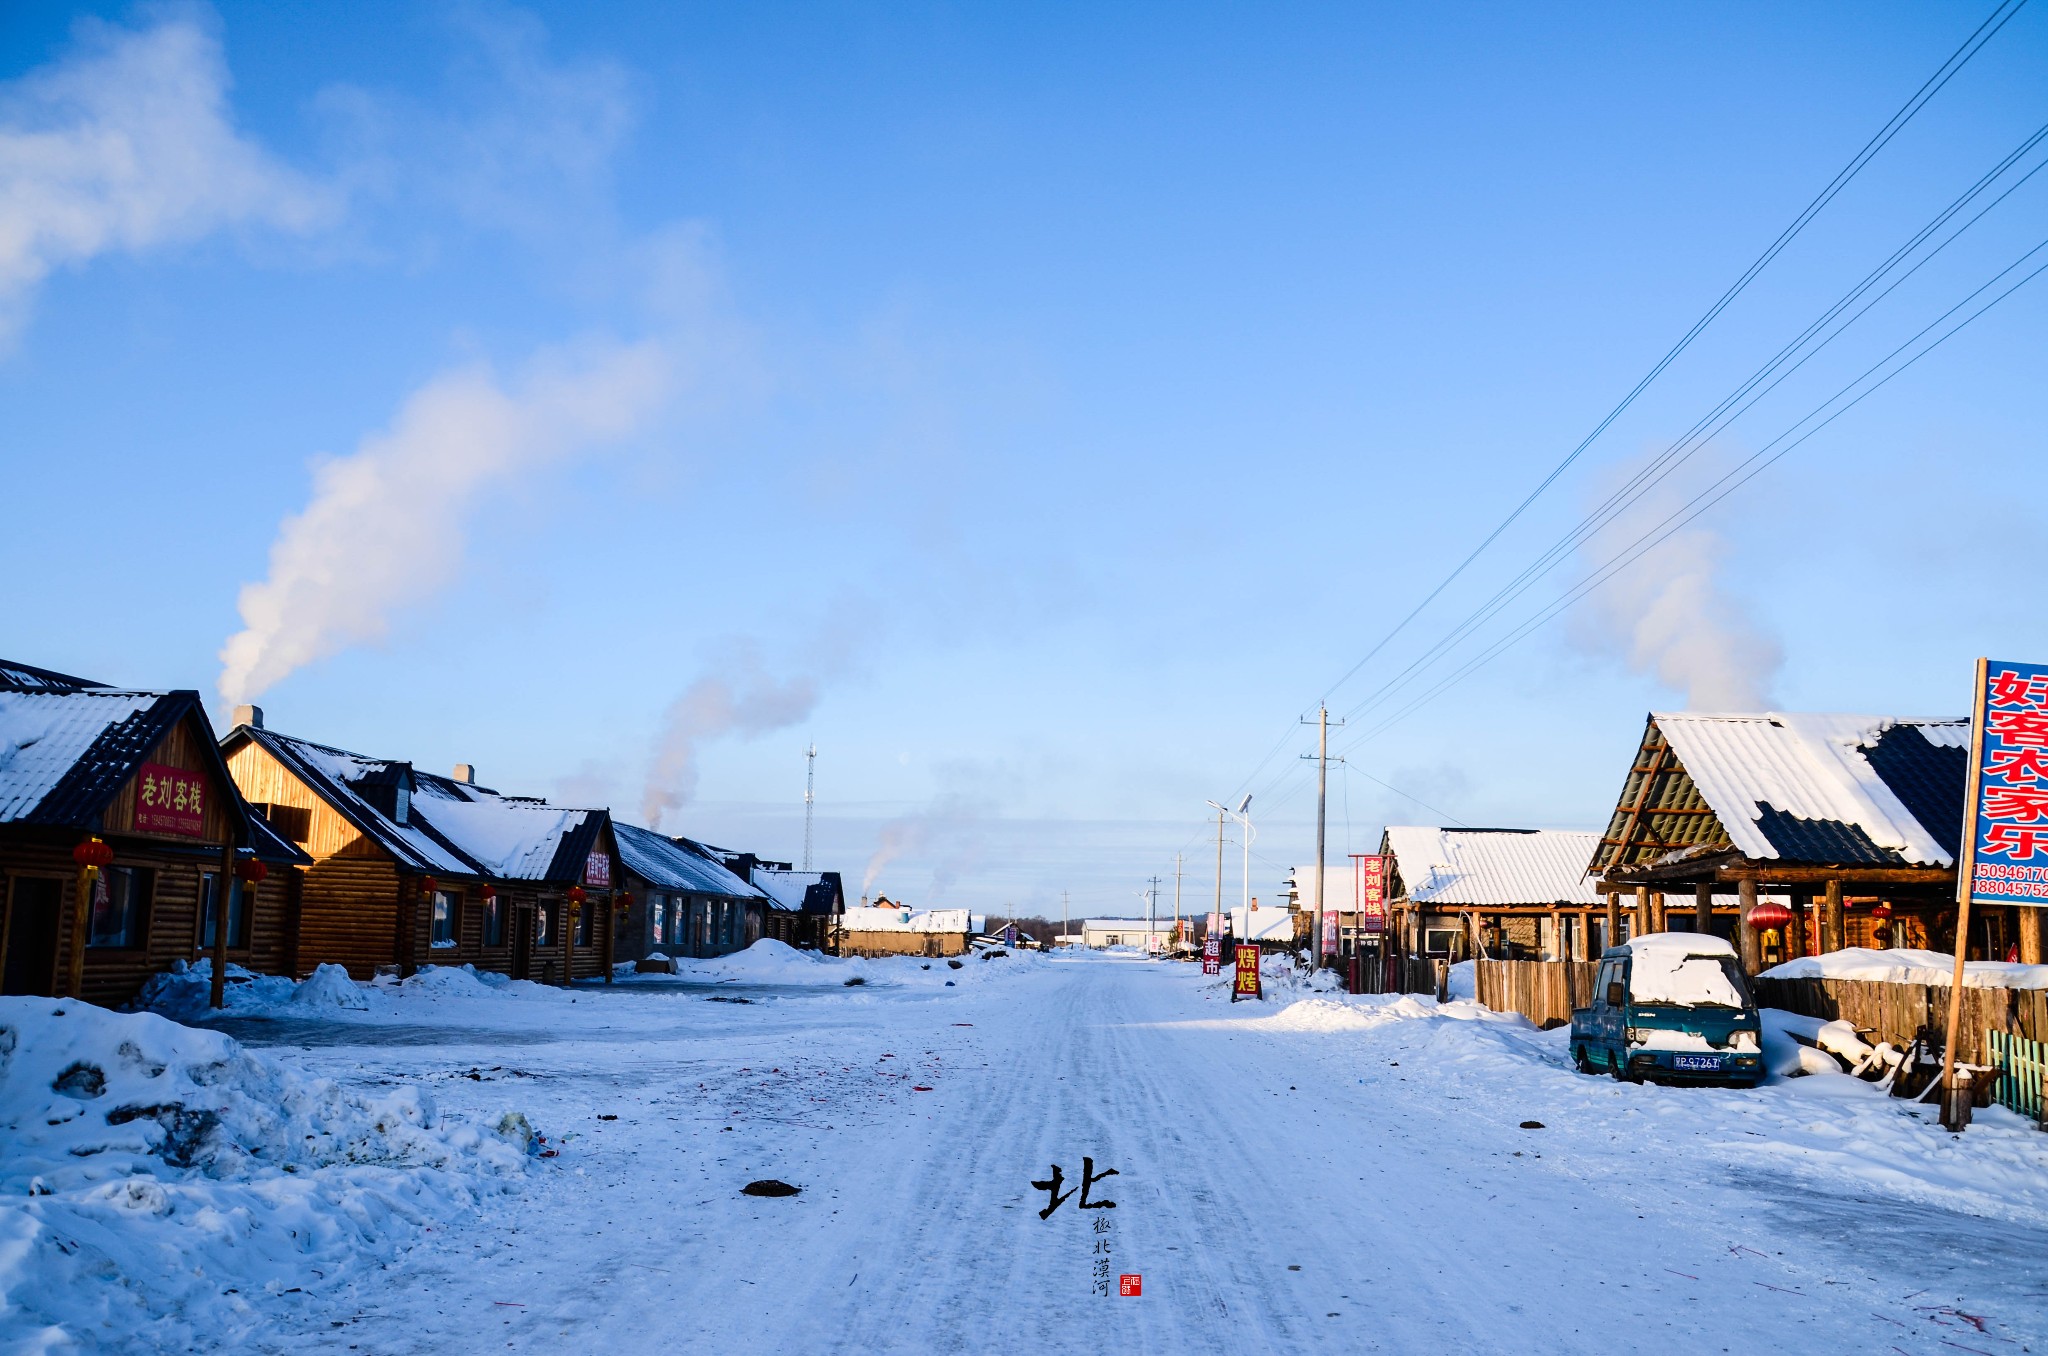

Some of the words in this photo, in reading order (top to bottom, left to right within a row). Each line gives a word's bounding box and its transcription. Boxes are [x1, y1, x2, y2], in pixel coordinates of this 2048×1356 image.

[1978, 670, 2048, 861] 好客农家乐
[141, 772, 202, 815] 老刘客栈
[1365, 859, 1382, 916] 老刘客栈
[1205, 941, 1219, 974] 超市
[1238, 948, 1256, 991] 烧烤
